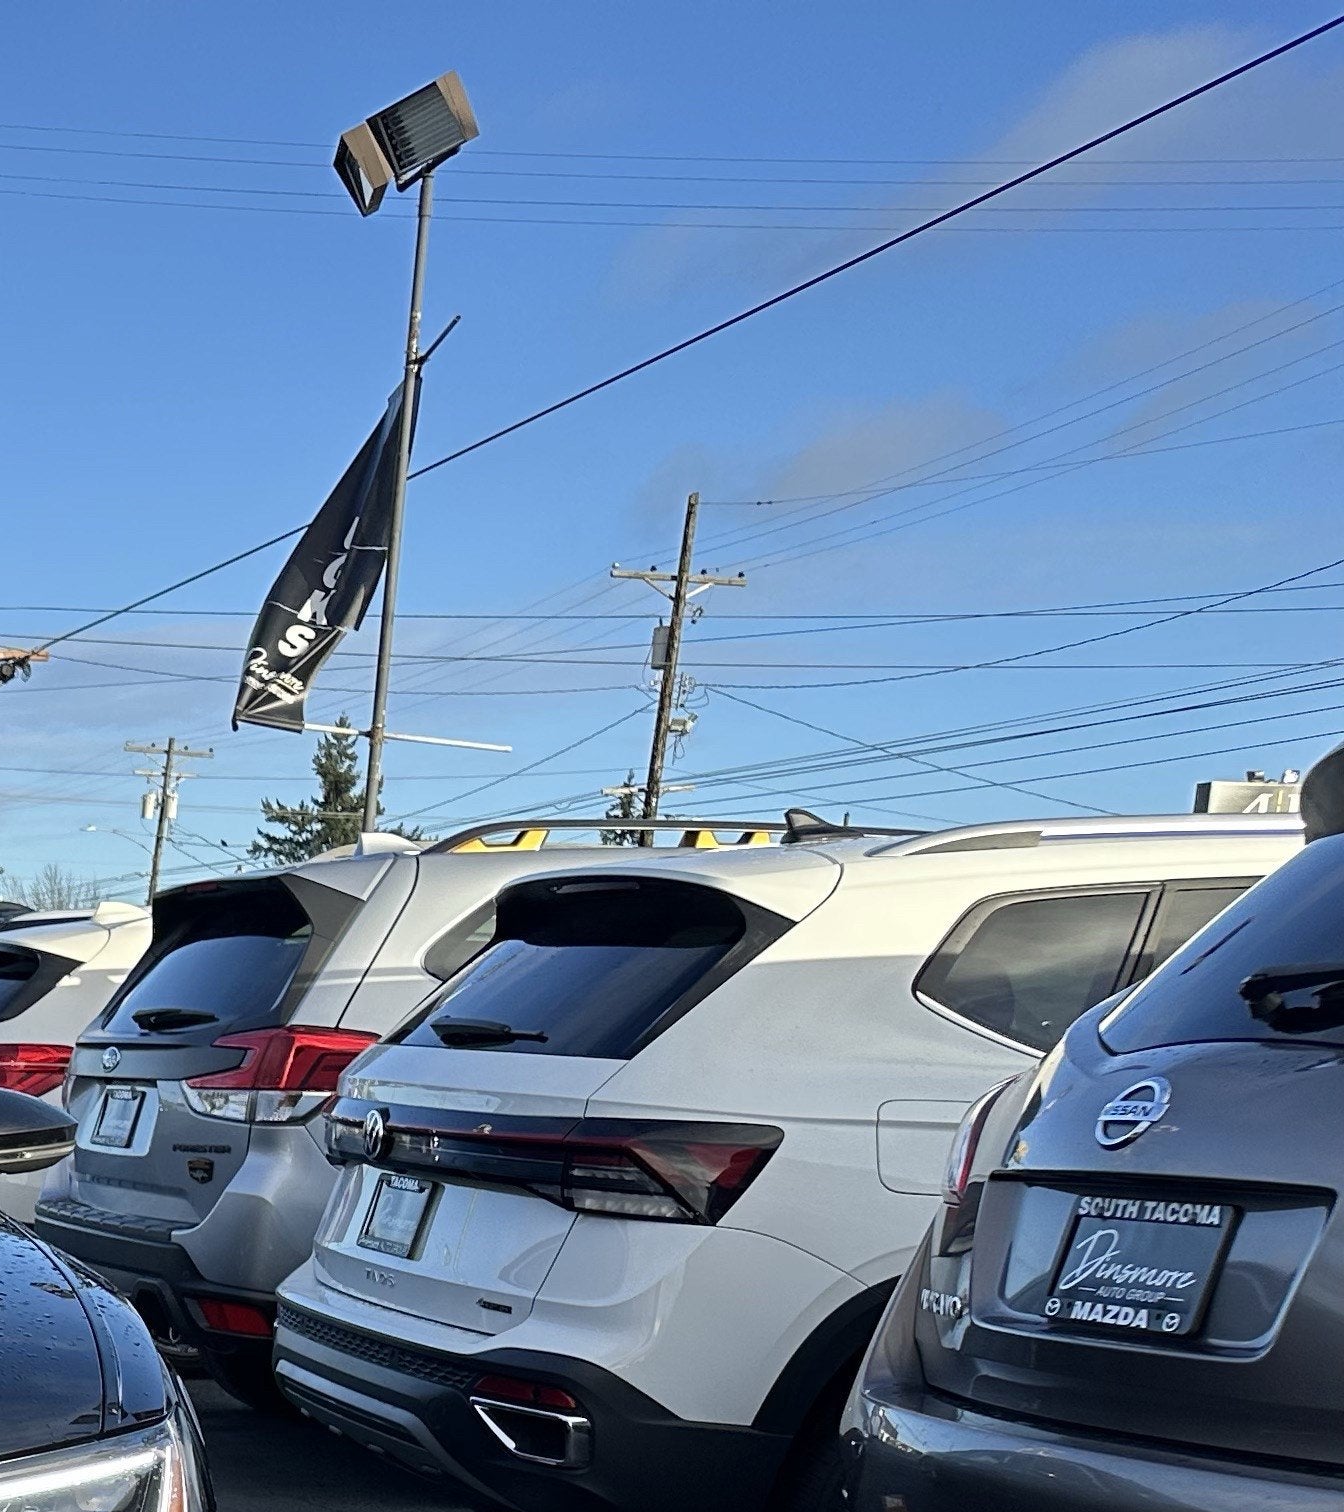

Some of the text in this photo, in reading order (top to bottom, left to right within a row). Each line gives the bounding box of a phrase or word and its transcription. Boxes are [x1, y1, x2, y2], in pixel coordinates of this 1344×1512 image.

[1077, 1196, 1222, 1226] SOUTH TACOMA
[1058, 1228, 1197, 1290] Dinsmore
[1095, 1286, 1167, 1303] AUTO GROUP
[1069, 1300, 1149, 1329] MAZDA
